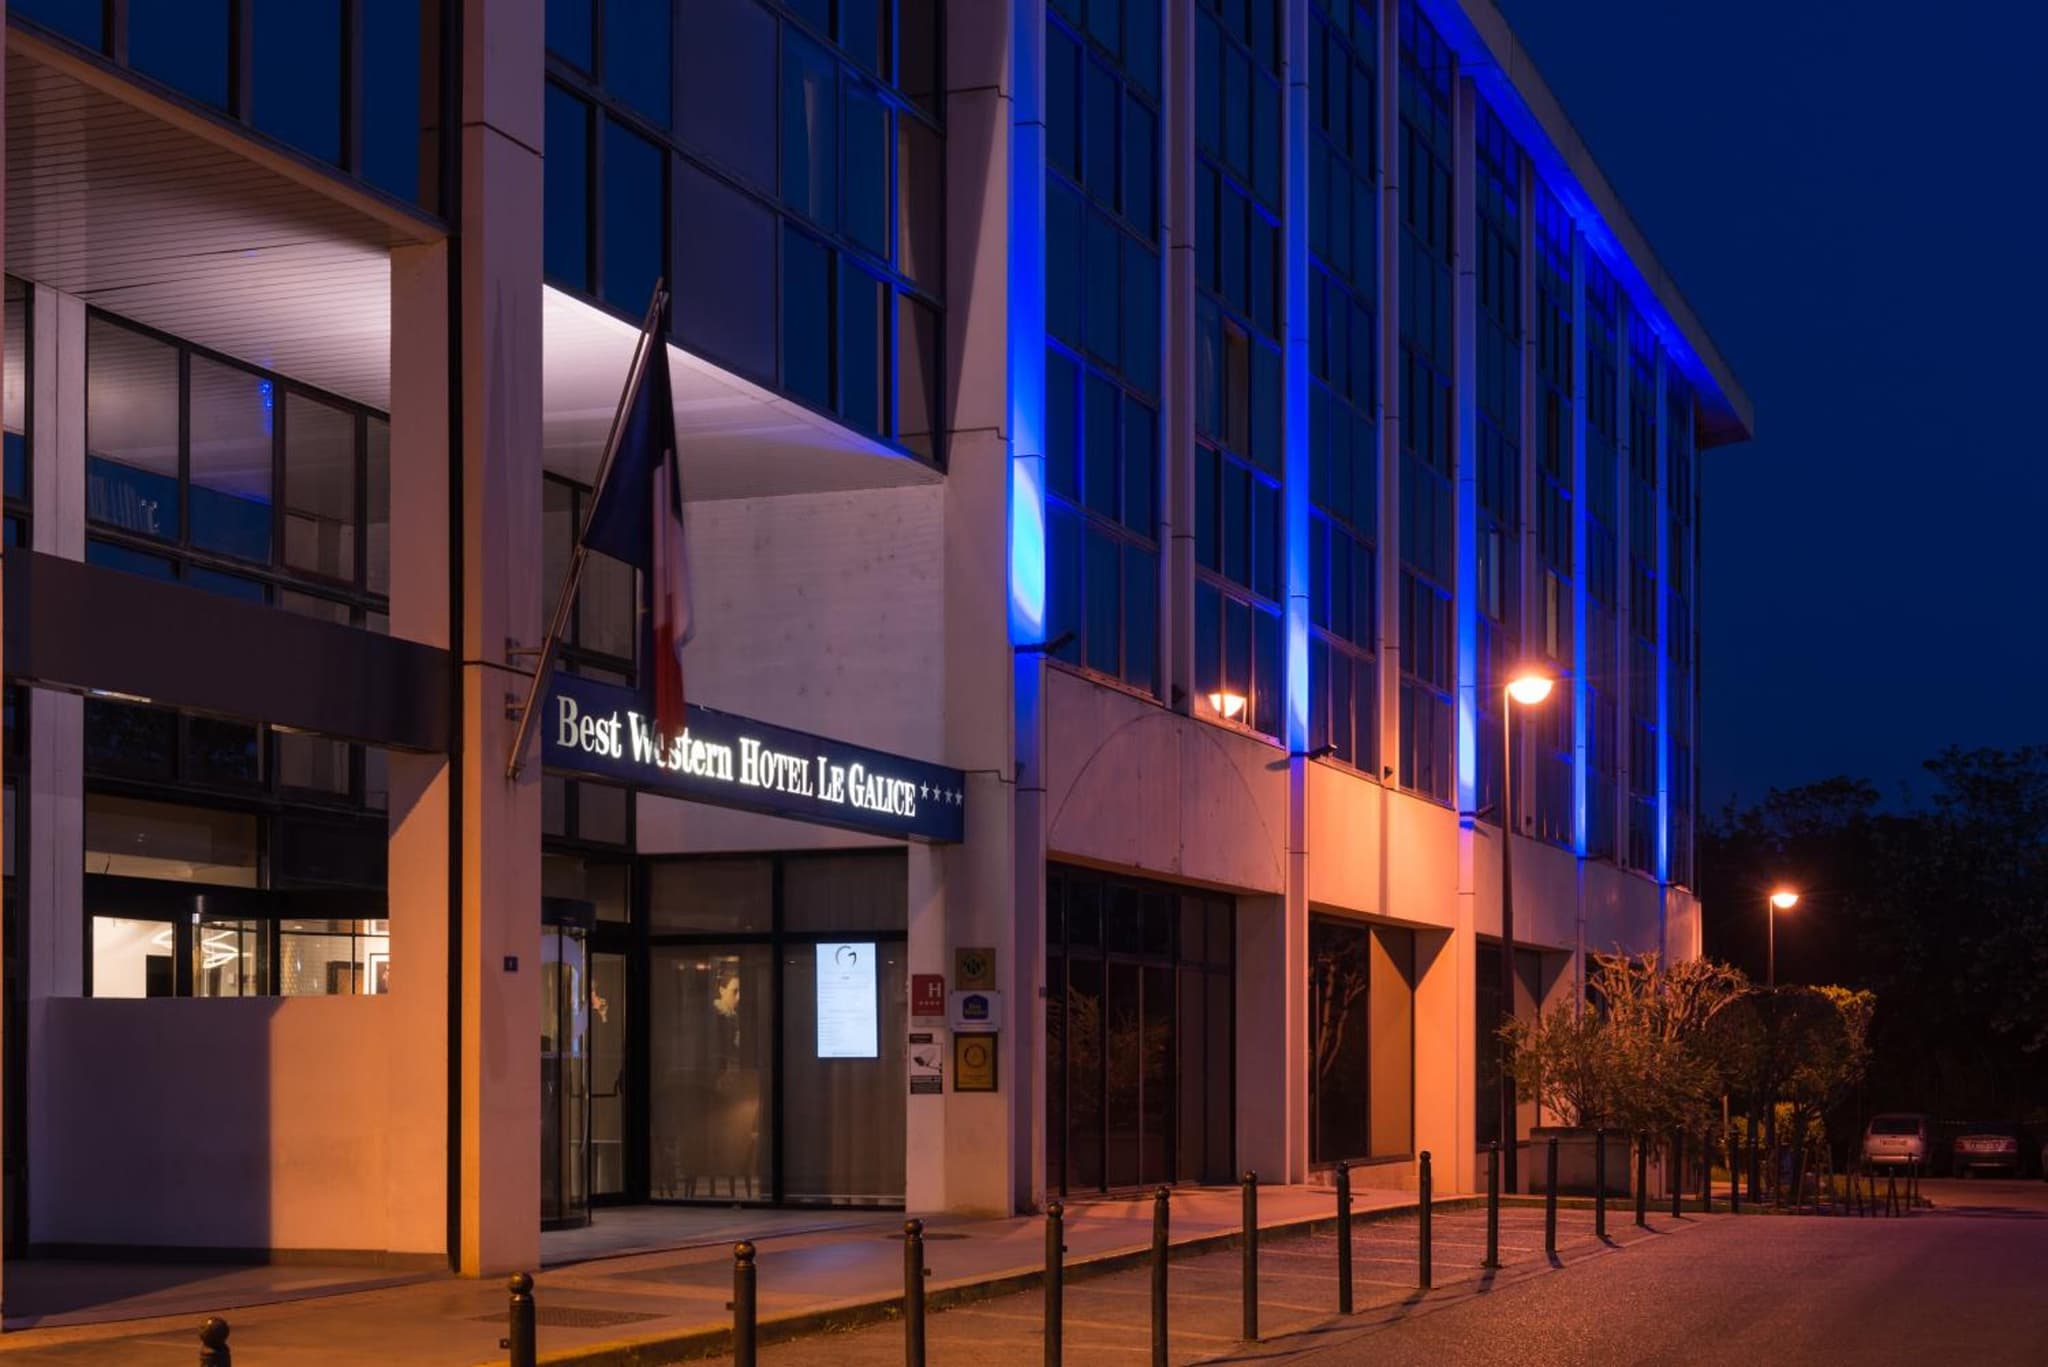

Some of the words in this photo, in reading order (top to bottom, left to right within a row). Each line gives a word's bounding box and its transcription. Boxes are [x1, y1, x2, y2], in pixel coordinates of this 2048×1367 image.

[556, 695, 622, 759] Best
[739, 737, 813, 797] HOTEL
[817, 756, 845, 804] LE
[849, 762, 916, 818] GALICE
[928, 982, 942, 998] H
